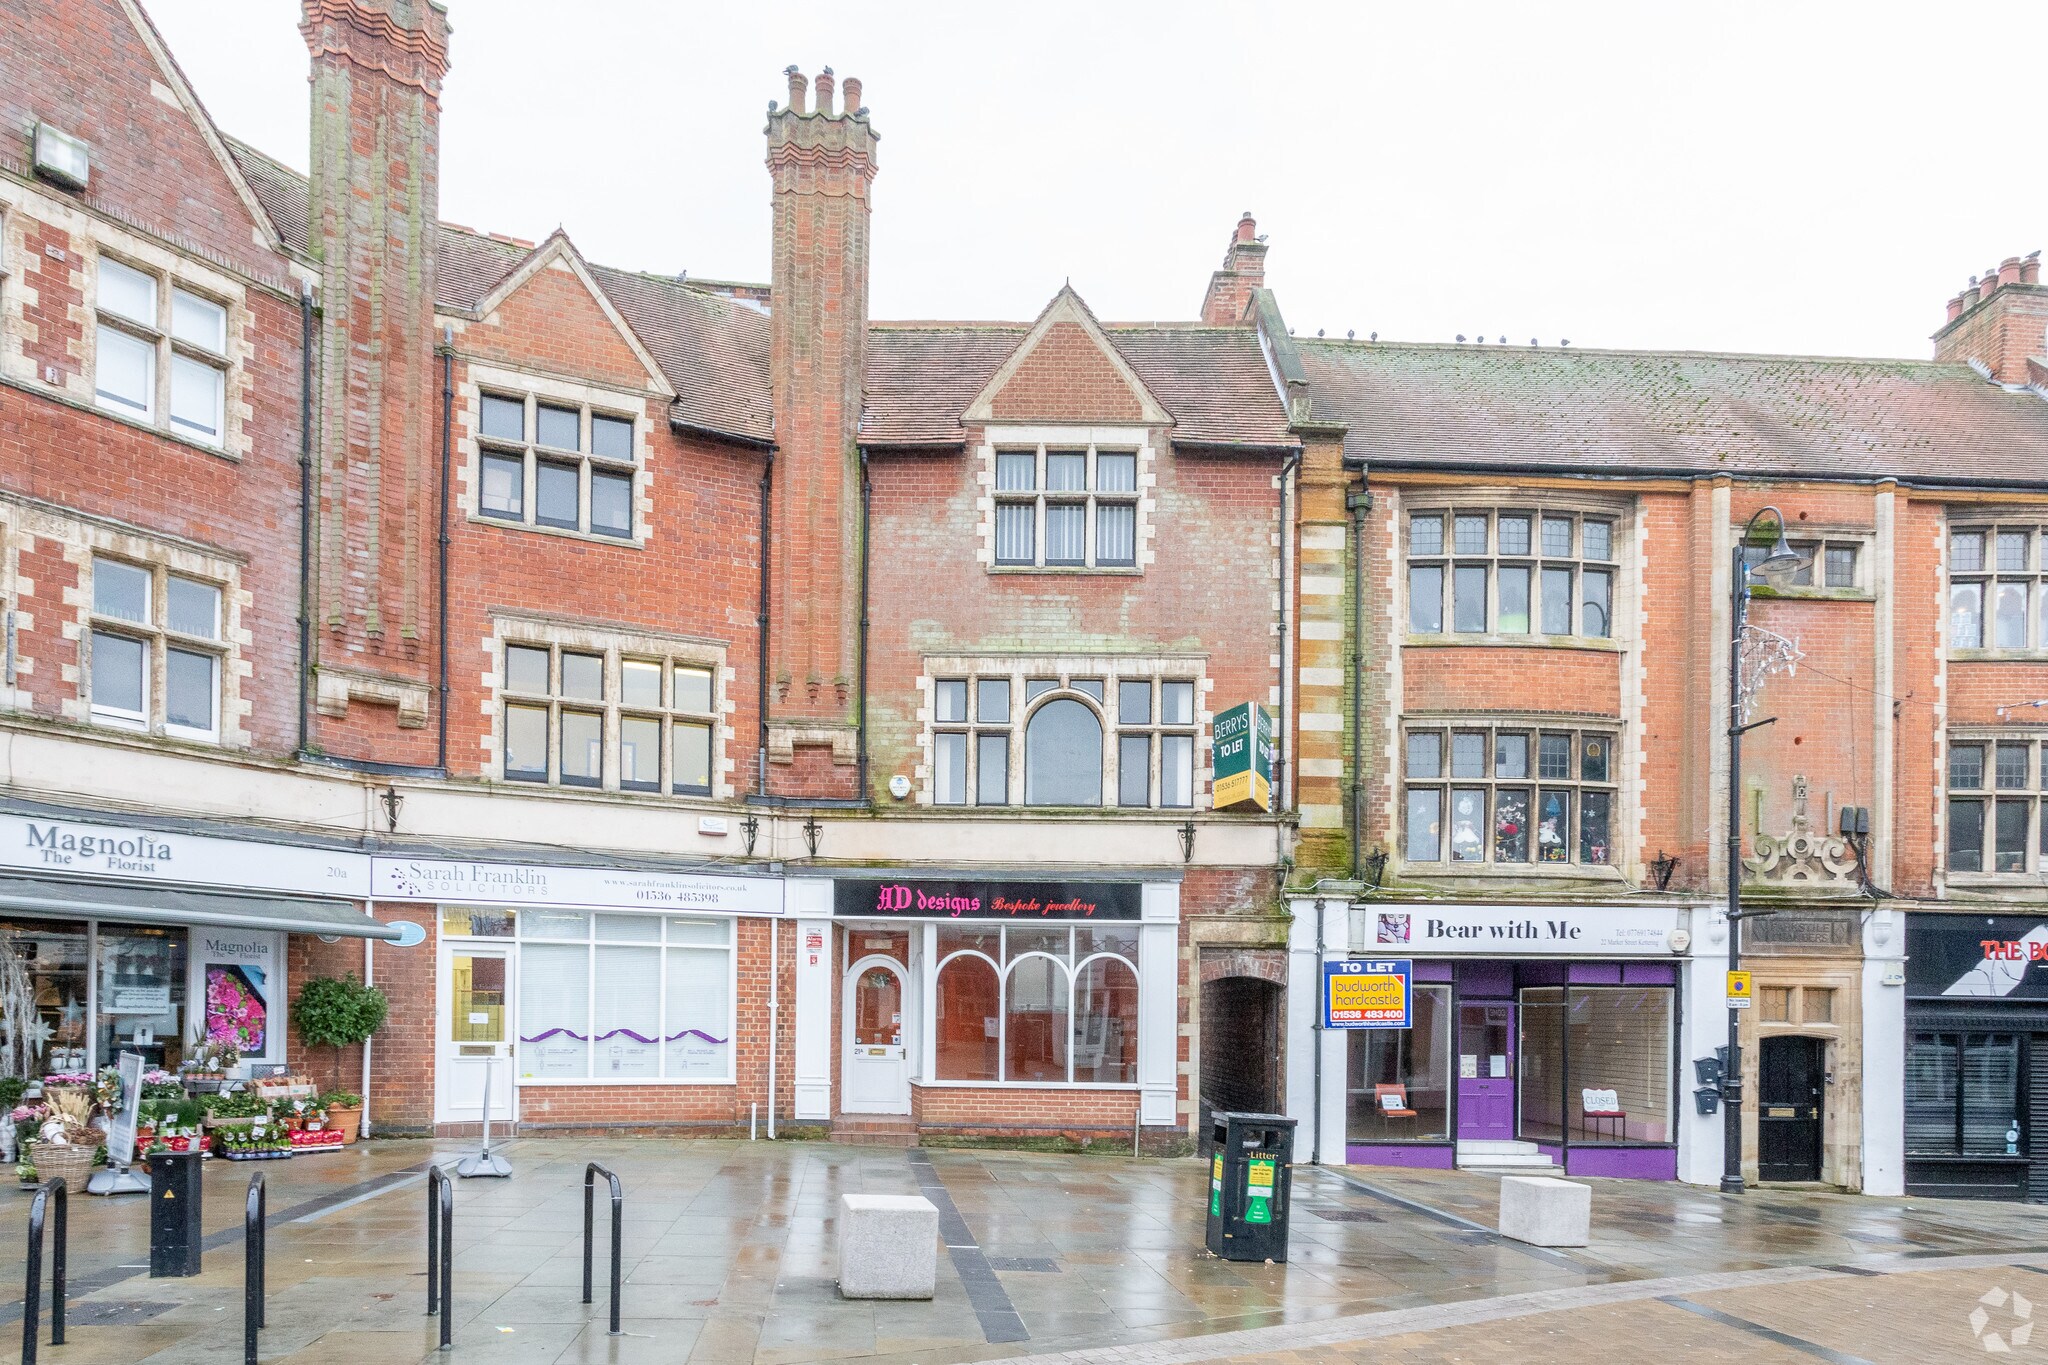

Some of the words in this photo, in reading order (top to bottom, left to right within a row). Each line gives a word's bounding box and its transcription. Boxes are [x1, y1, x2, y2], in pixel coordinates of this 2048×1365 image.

[1214, 713, 1248, 740] BERRYS
[1220, 744, 1231, 758] TO
[1232, 739, 1243, 754] LET
[26, 823, 172, 860] Magnolia
[41, 850, 73, 864] The
[108, 857, 155, 872] Florist
[326, 866, 348, 879] 20a
[409, 862, 464, 881] Sarah
[472, 865, 547, 885] Franklin
[427, 881, 548, 896] SOLICITORS
[604, 878, 748, 893] www.sarahfranklinsolicitors.co.uk
[636, 890, 672, 901] 01536
[677, 891, 719, 904] 485398
[876, 884, 912, 912] AD
[917, 889, 980, 918] designs
[990, 896, 1041, 914] Bespoke
[1042, 898, 1096, 916] jewellery
[1426, 919, 1482, 938] Bear
[1489, 920, 1538, 939] with
[1545, 920, 1582, 940] Me
[204, 939, 269, 955] Magnolia
[1980, 939, 2023, 961] THE
[1340, 962, 1361, 973] TO
[1366, 962, 1396, 973] LET
[1335, 975, 1396, 992] budworth
[1335, 993, 1401, 1006] hardcastle
[1332, 1010, 1362, 1019] 01536
[1585, 1096, 1617, 1105] CLOSED
[1250, 1151, 1276, 1160] Litter
